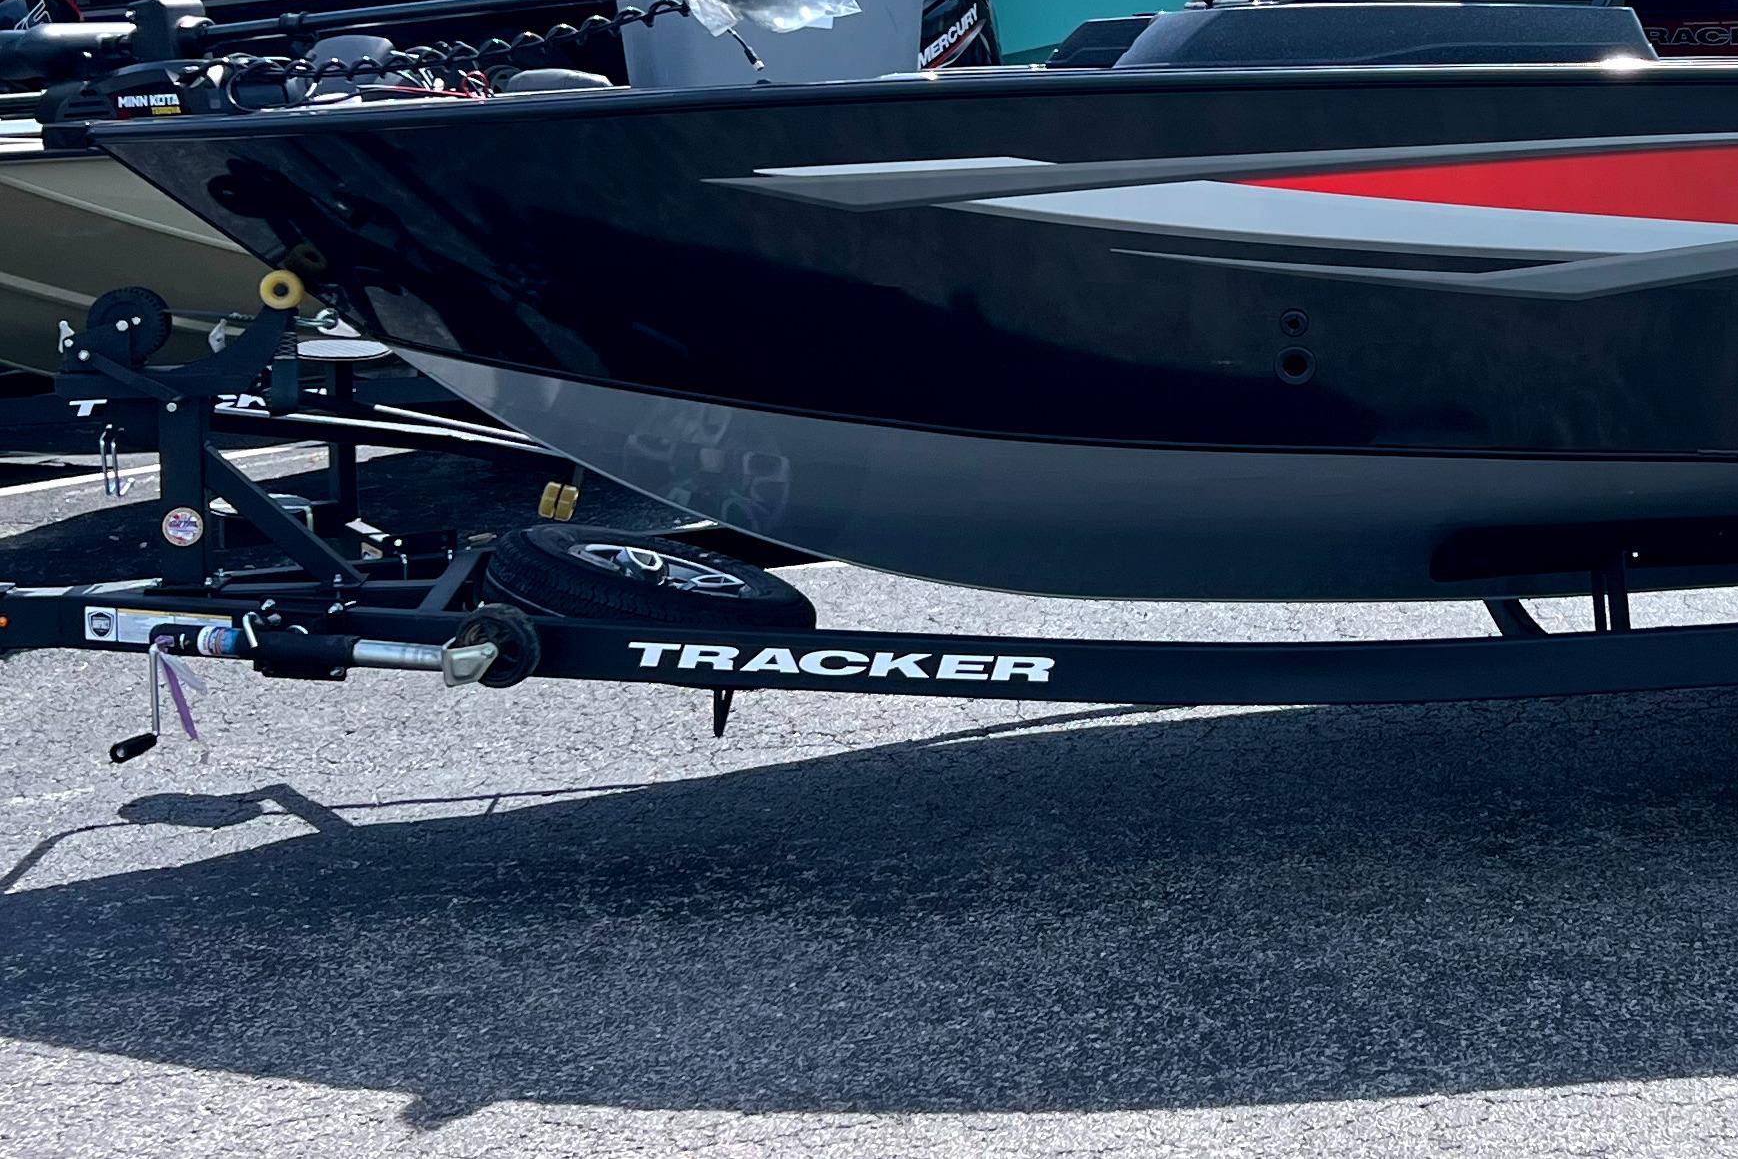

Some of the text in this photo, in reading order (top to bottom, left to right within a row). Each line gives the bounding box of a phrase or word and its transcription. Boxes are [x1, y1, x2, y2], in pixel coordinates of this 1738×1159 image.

[917, 3, 980, 70] MERCURY
[118, 94, 179, 108] MINN KOTA
[627, 641, 1056, 684] TRACKER
